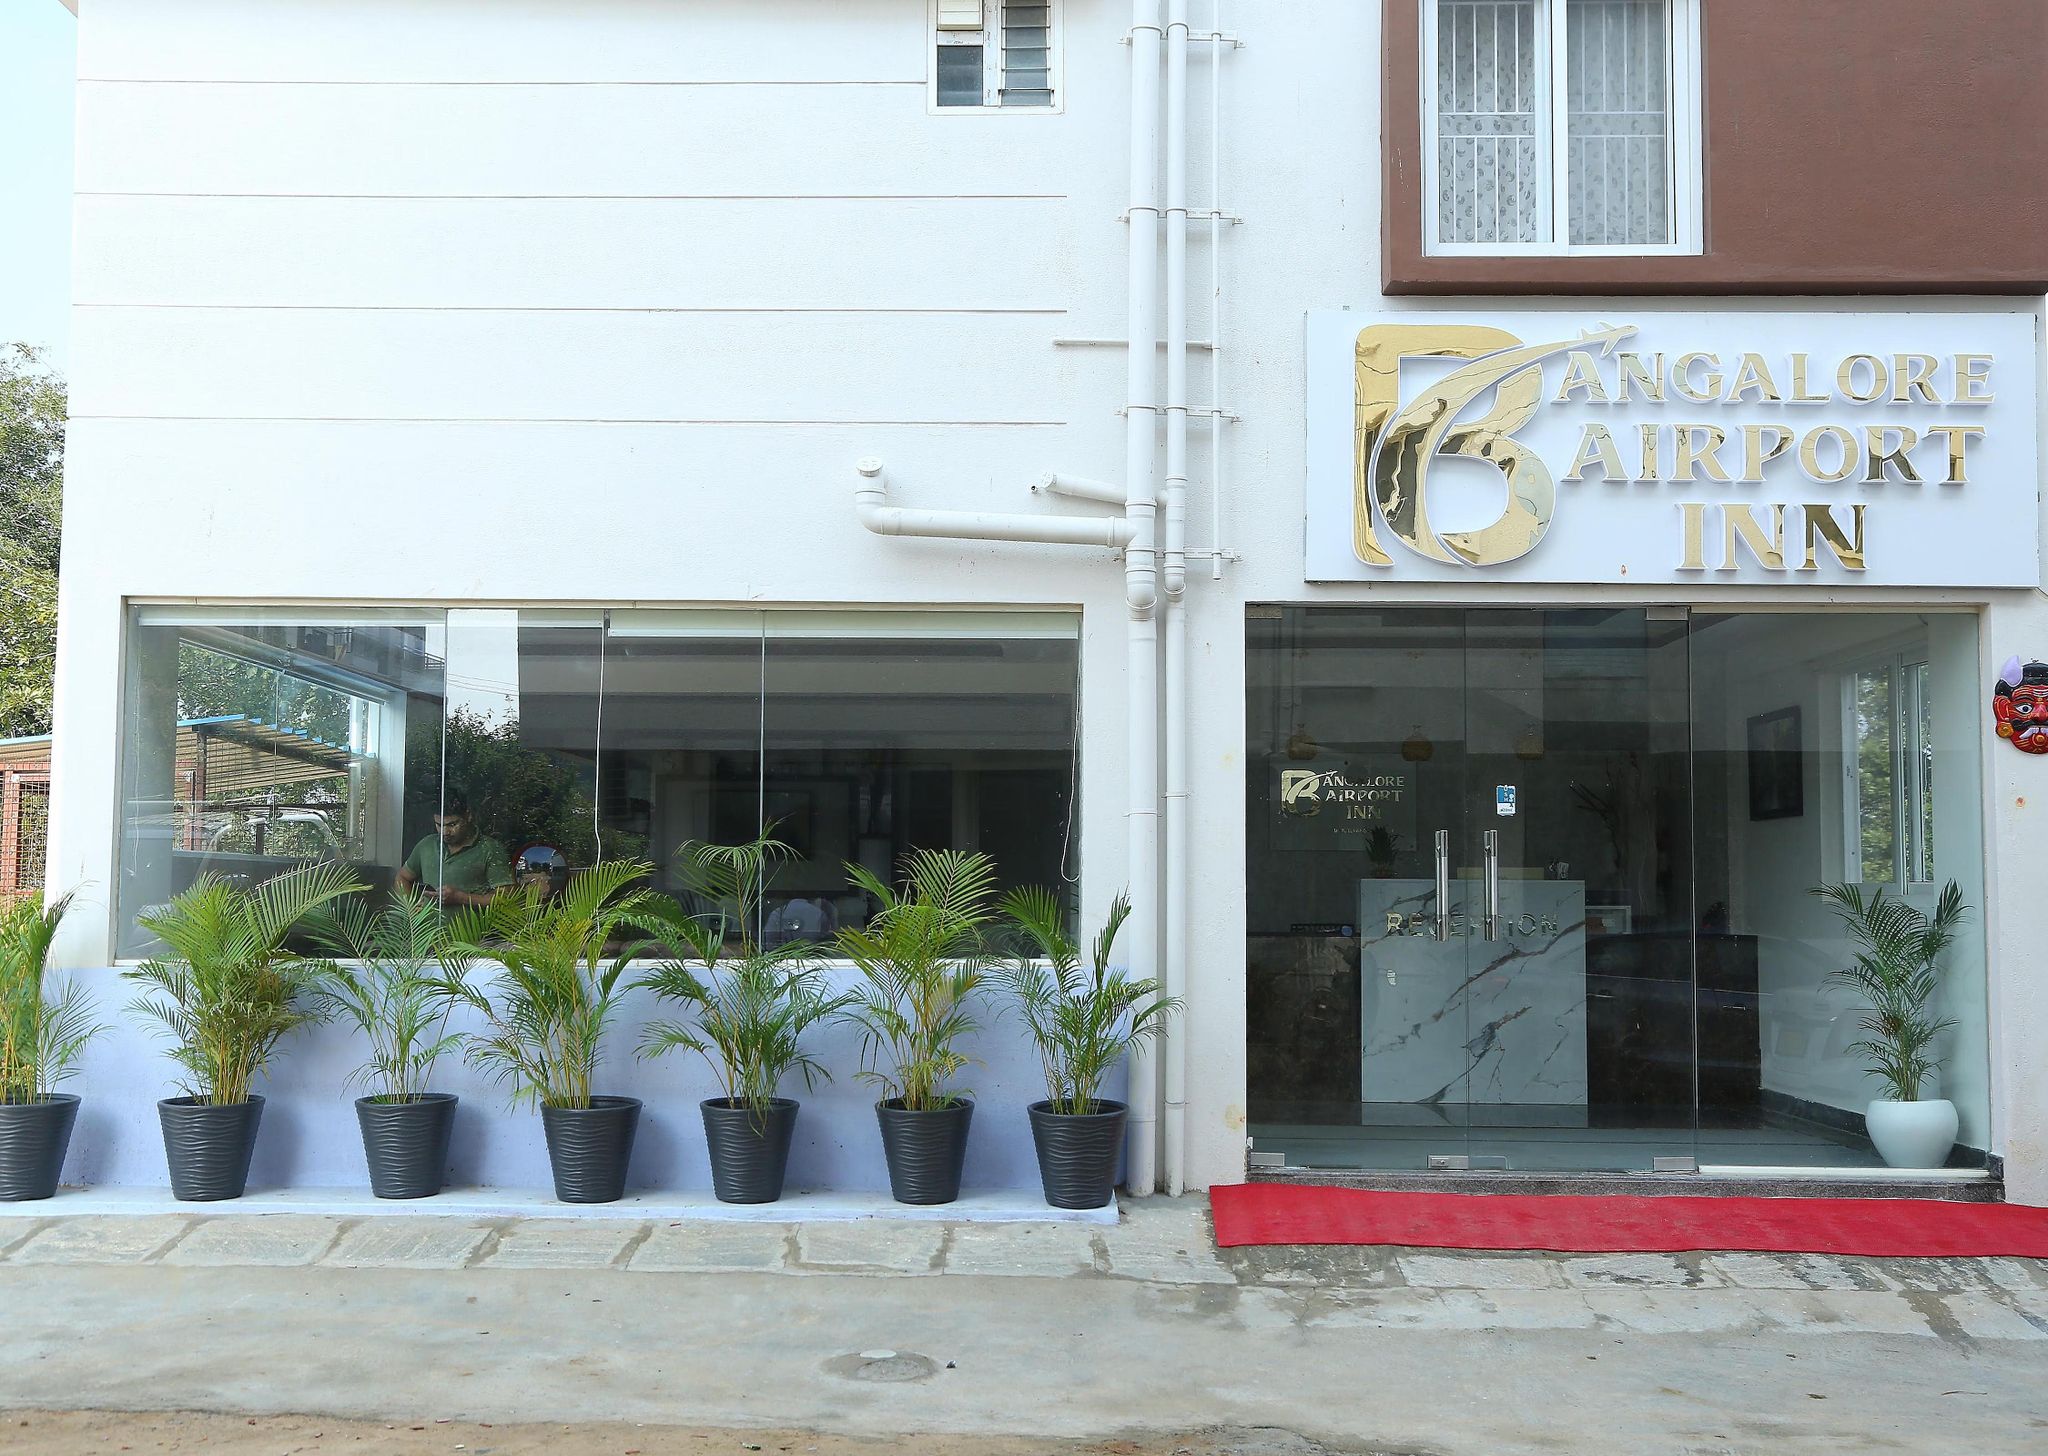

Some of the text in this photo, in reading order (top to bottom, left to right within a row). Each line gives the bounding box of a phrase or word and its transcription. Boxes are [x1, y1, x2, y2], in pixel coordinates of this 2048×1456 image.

[1561, 423, 1987, 485] AIRPORT
[1675, 502, 1869, 571] INN
[1325, 789, 1404, 803] AIRPORT
[1346, 805, 1382, 820] INN
